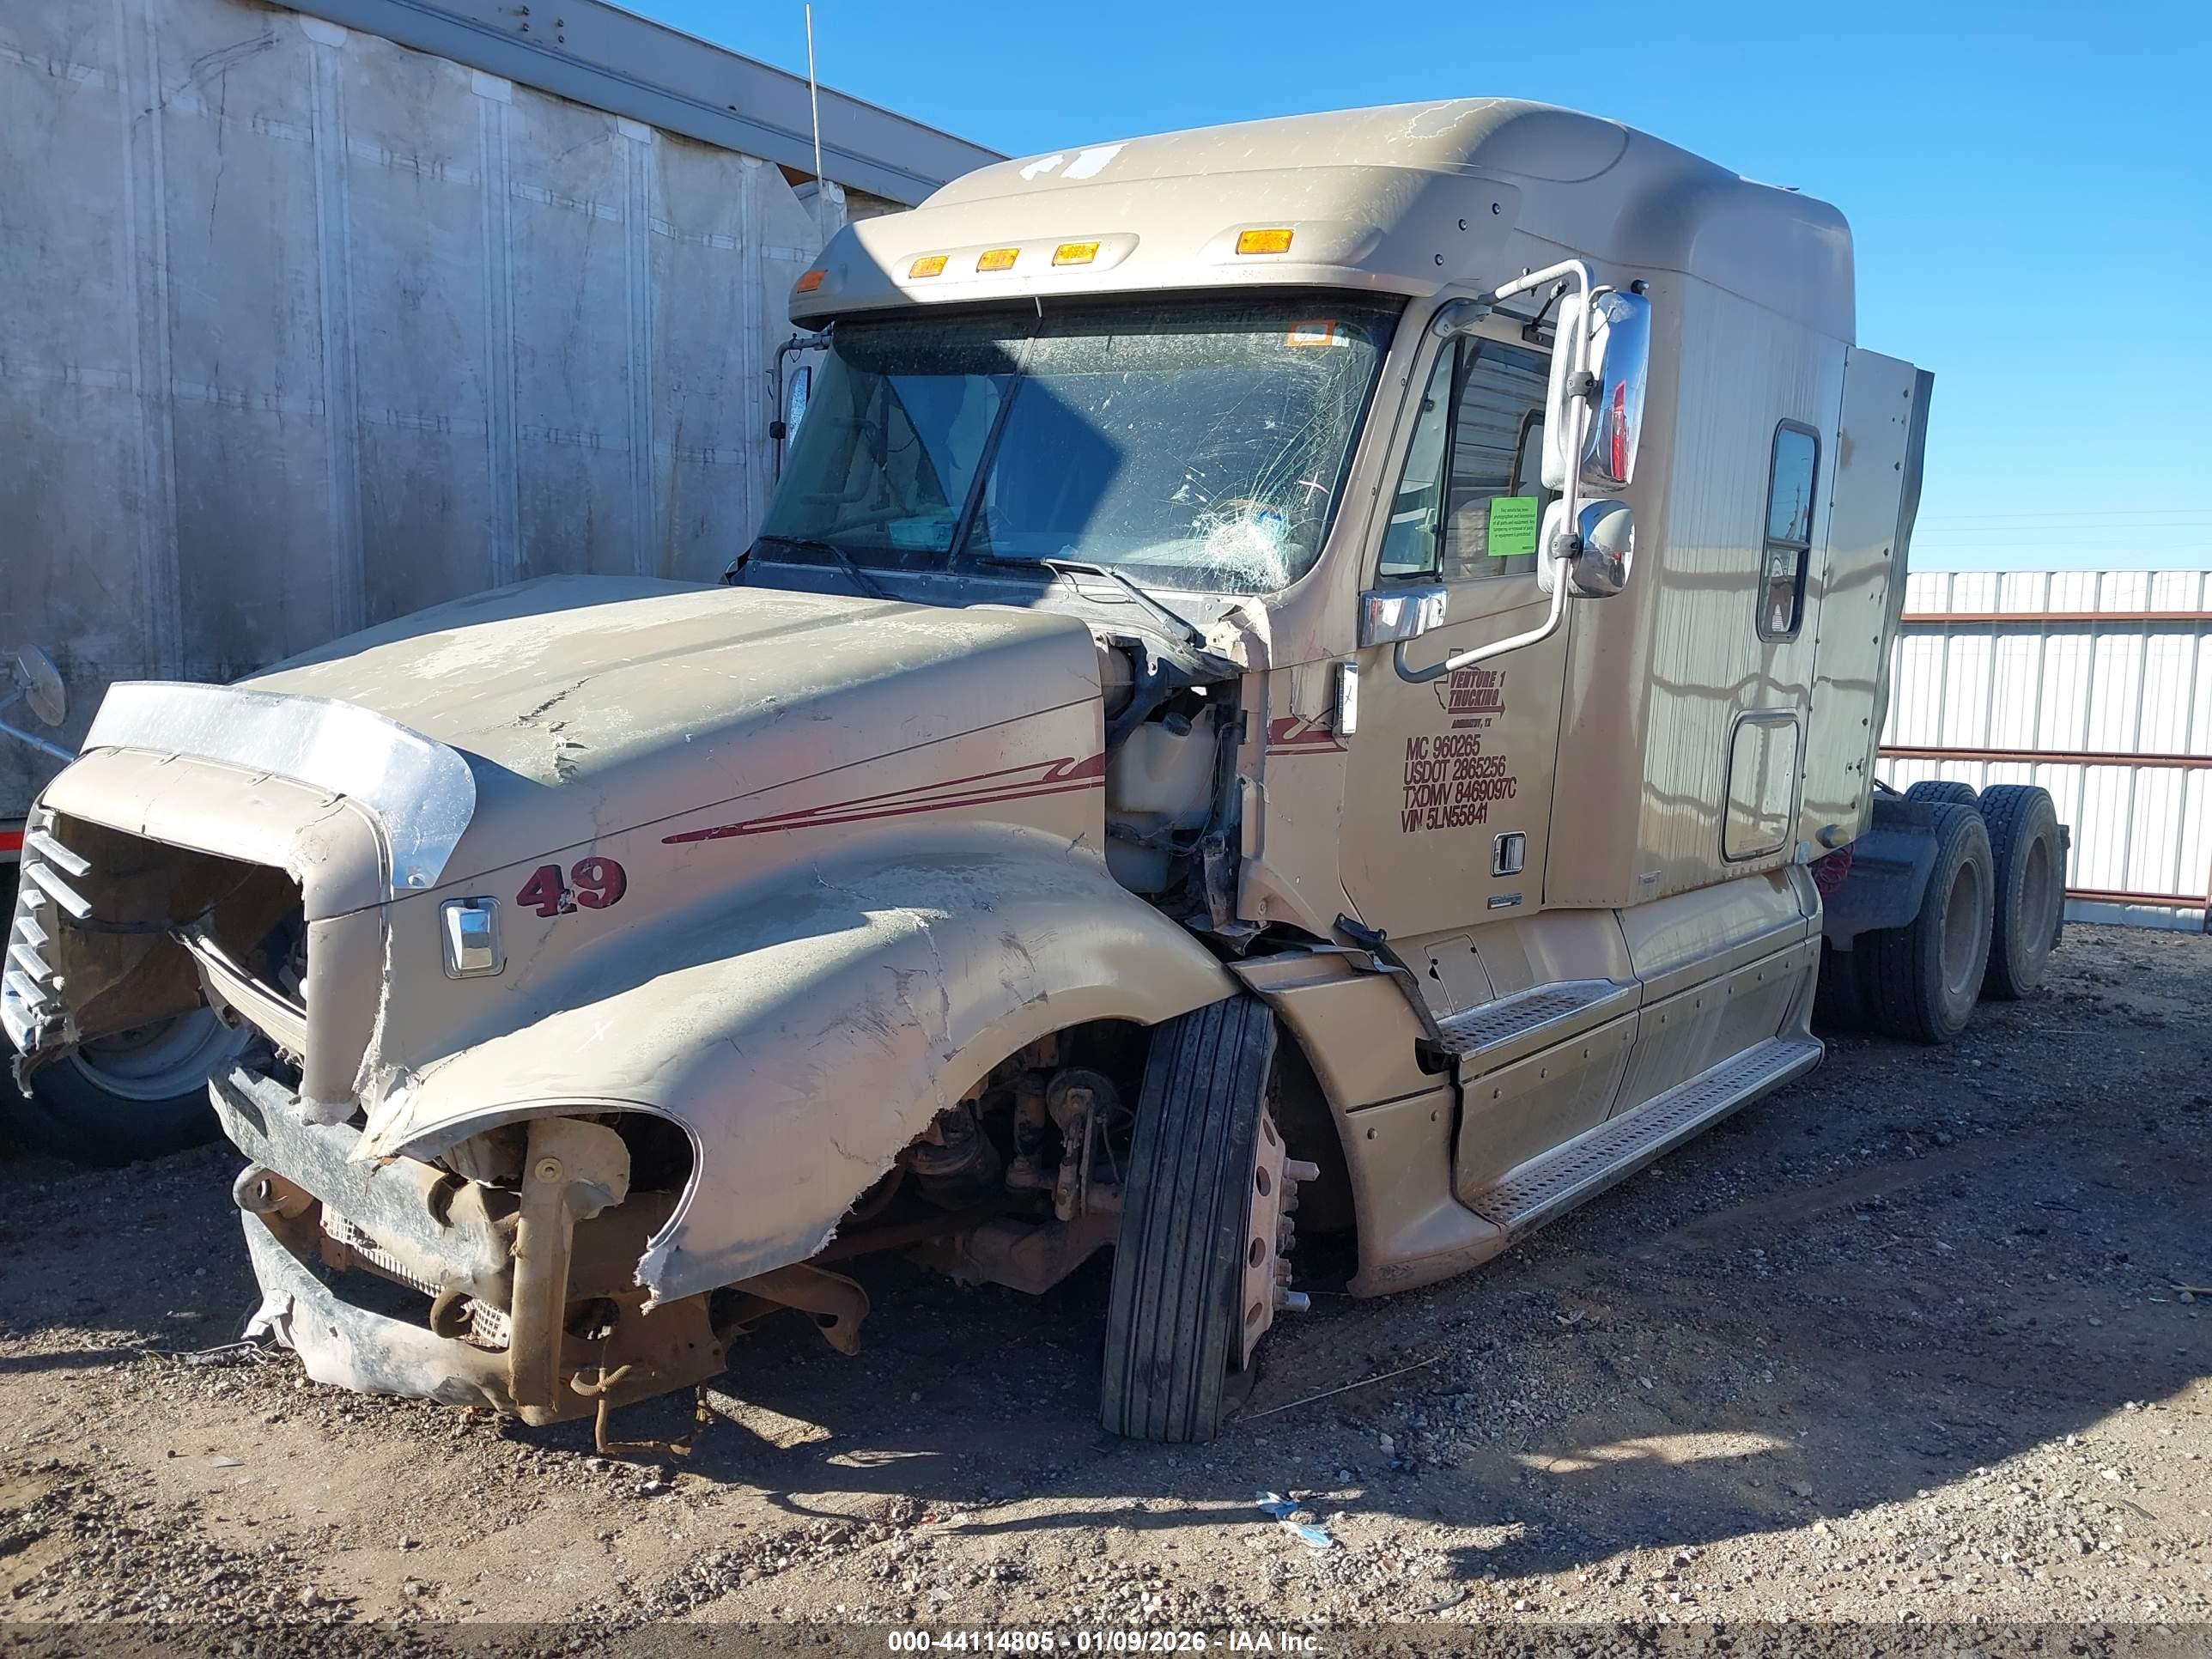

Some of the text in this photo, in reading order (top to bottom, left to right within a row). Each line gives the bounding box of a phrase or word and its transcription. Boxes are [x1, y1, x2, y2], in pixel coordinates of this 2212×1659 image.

[1449, 671, 1506, 688] VENTURE 1
[1449, 689, 1499, 707] TRUCKING
[1406, 734, 1480, 761] MC 960265
[1403, 756, 1506, 785] USDOT 2865256
[1402, 776, 1517, 810] TXDMV 8469097C
[1401, 802, 1488, 833] VIN 5LN55841
[516, 857, 627, 918] 49
